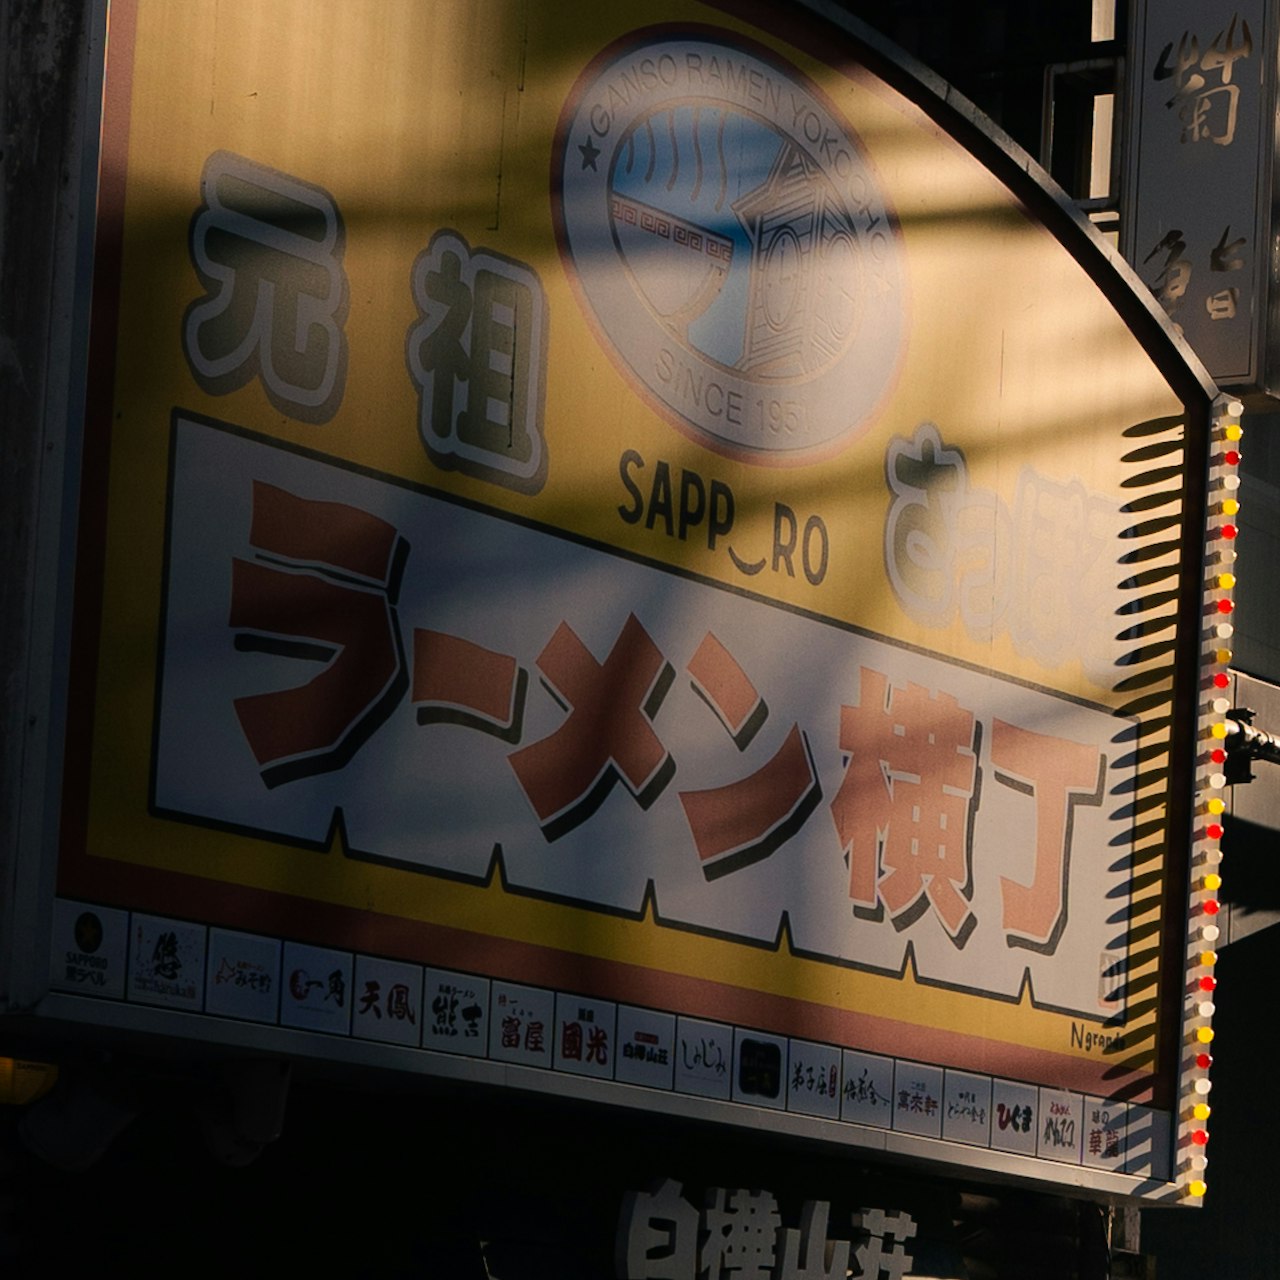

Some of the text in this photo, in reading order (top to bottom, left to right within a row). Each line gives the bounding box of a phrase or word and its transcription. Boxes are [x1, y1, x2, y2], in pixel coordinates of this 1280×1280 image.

[589, 54, 677, 140] GANSO
[684, 53, 781, 114] RAMEN
[182, 150, 550, 497] 元祖
[230, 480, 1106, 952] ラーメン横丁
[65, 951, 108, 971] SAPPORO
[305, 969, 345, 1007] 一角
[358, 980, 416, 1026] 天鳳
[432, 995, 483, 1037] 熊吉
[501, 1015, 545, 1053] 富屋
[561, 1020, 608, 1066] 國光
[997, 1103, 1033, 1133] ひぐま
